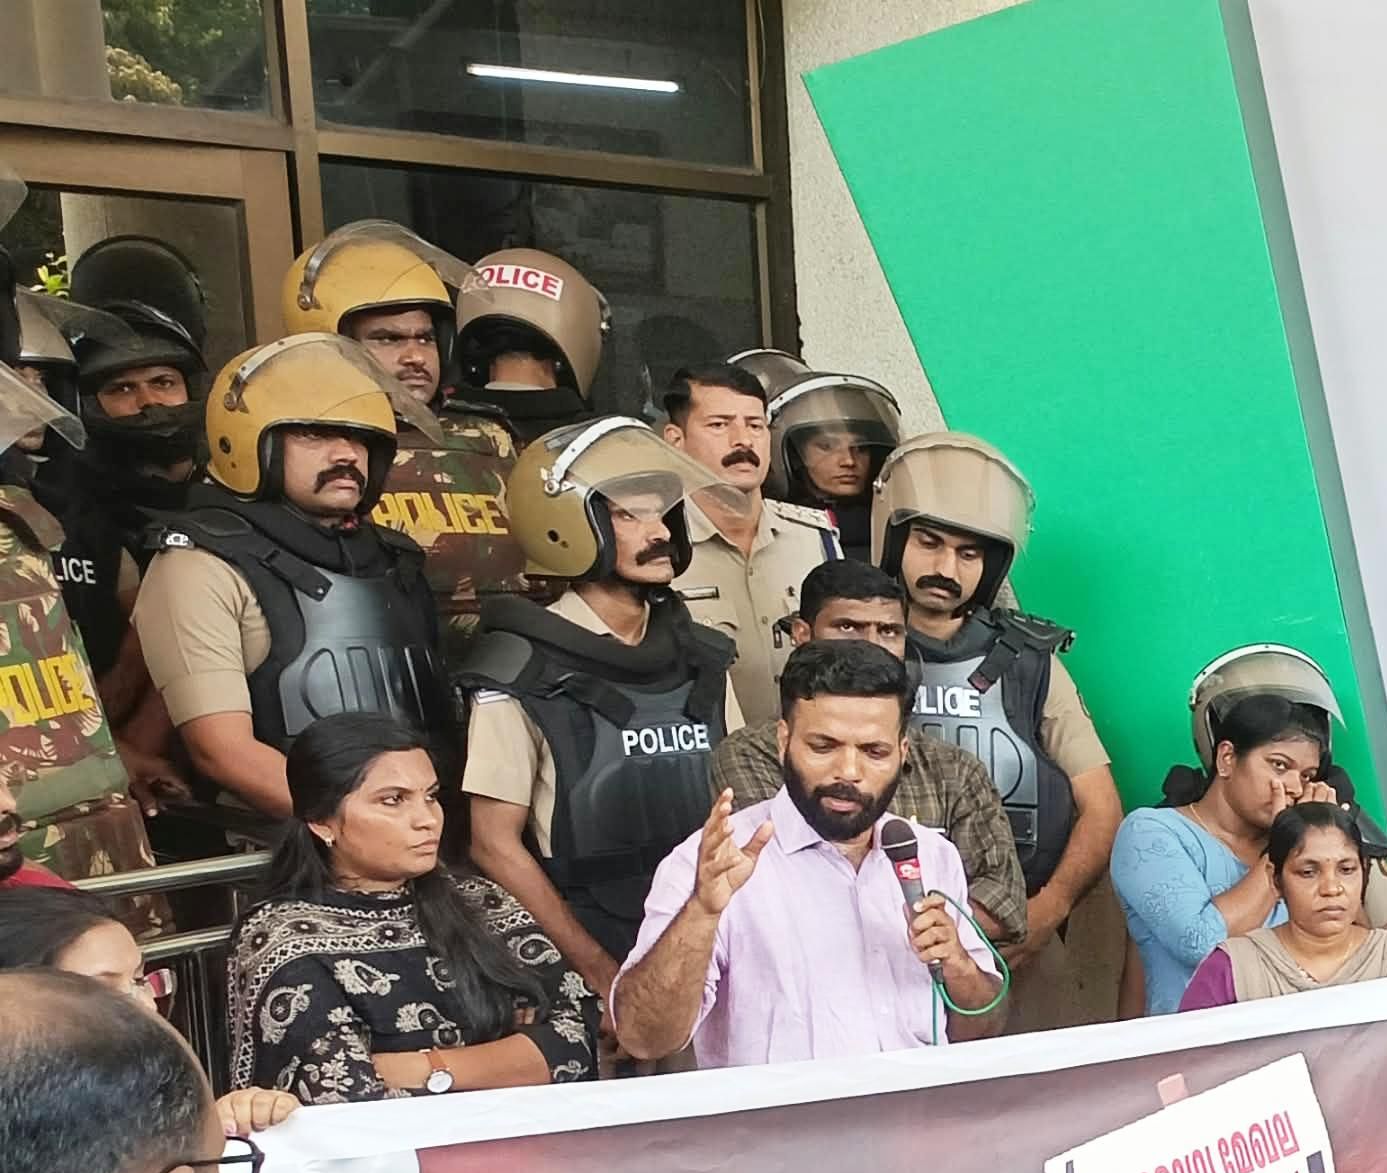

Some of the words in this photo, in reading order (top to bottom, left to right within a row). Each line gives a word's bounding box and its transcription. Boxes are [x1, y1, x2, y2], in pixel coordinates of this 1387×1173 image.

[481, 267, 560, 297] OLICE
[0, 654, 95, 725] OLICE
[912, 685, 981, 718] LICE
[622, 724, 711, 756] POLICE
